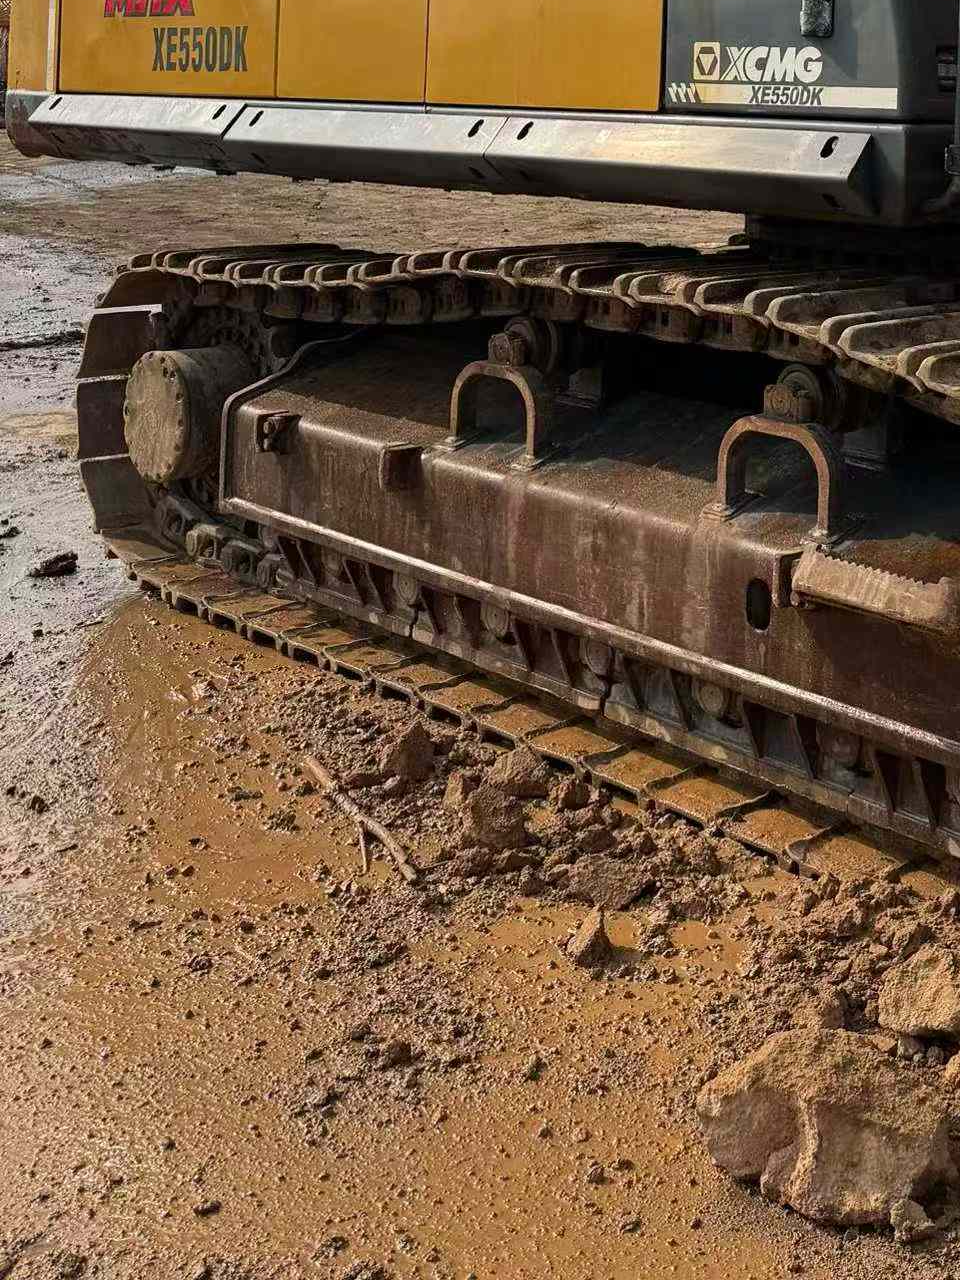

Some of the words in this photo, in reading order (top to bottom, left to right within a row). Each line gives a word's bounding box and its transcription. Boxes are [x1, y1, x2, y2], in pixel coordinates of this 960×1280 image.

[151, 26, 248, 72] XE550DK
[720, 46, 823, 84] XCMG
[749, 85, 823, 106] XE550DK
